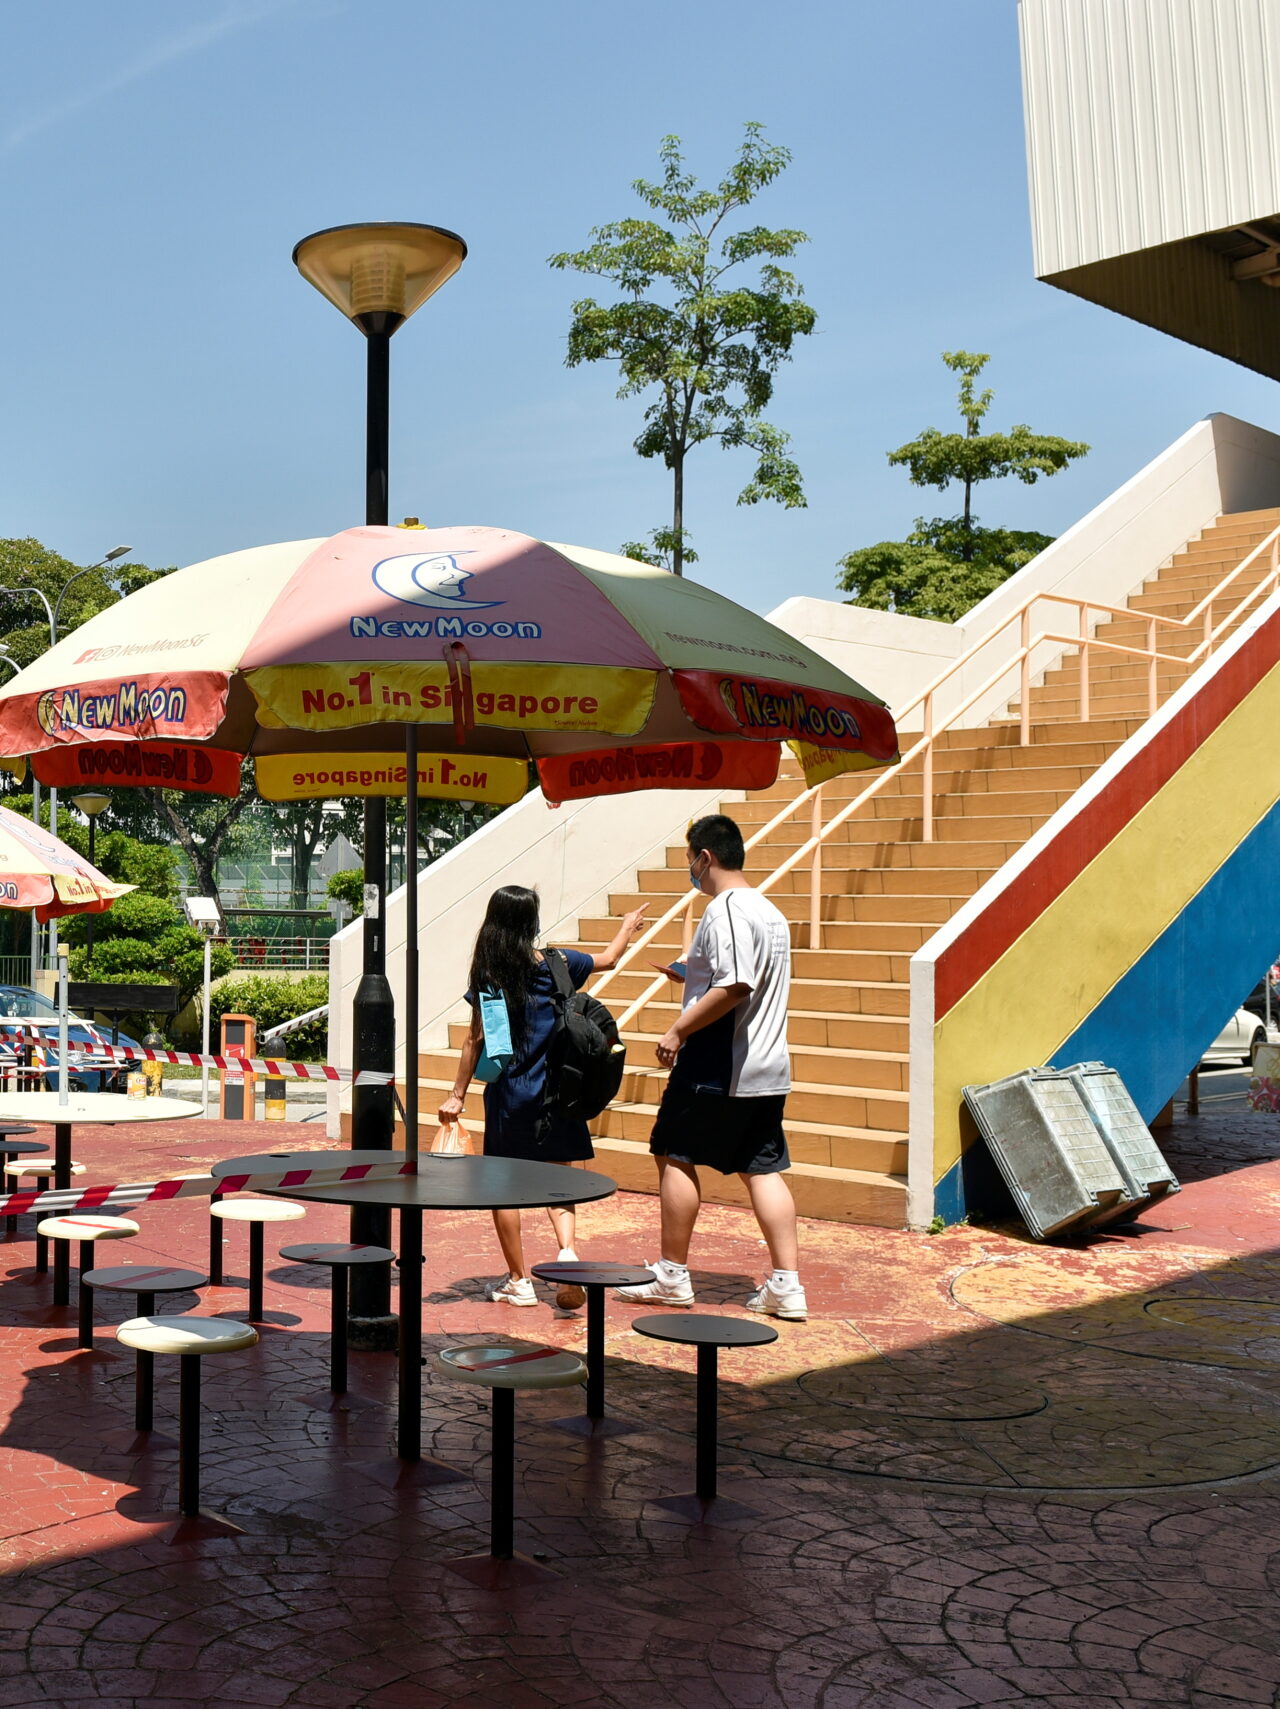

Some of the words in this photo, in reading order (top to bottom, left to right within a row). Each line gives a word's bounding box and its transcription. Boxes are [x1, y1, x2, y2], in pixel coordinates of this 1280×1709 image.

[119, 633, 210, 657] NewMoonSG
[382, 685, 411, 706] in
[420, 685, 598, 718] Sigapore
